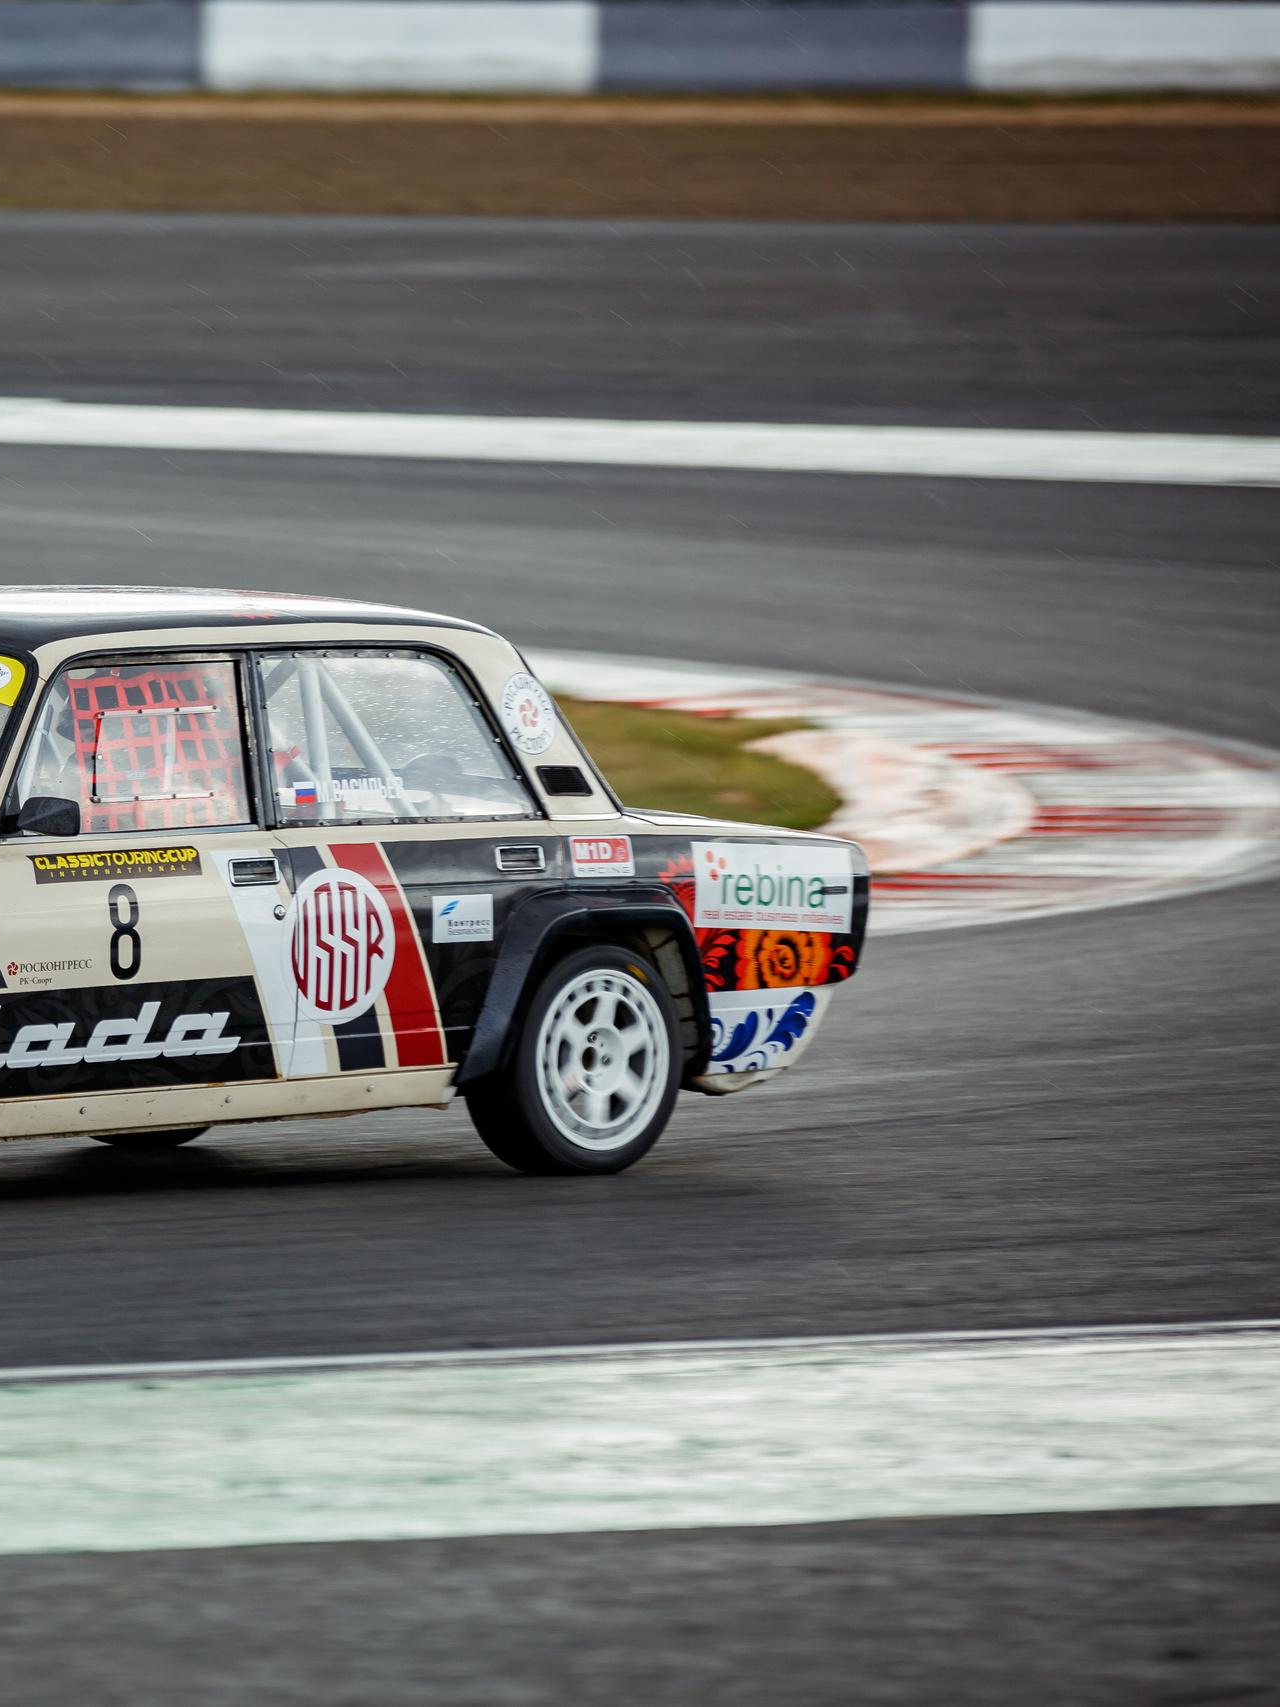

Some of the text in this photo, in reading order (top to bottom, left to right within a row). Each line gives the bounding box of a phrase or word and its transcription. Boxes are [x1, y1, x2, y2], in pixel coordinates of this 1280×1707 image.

[34, 848, 198, 870] CLASSICTOURINGCUP
[50, 864, 187, 878] INTERNATIONAL
[721, 863, 826, 909] rebina
[108, 883, 142, 981] 8
[291, 881, 384, 1012] USSR
[19, 958, 93, 973] РОСКОНГРЕСС
[19, 976, 53, 986] РК-Спорт
